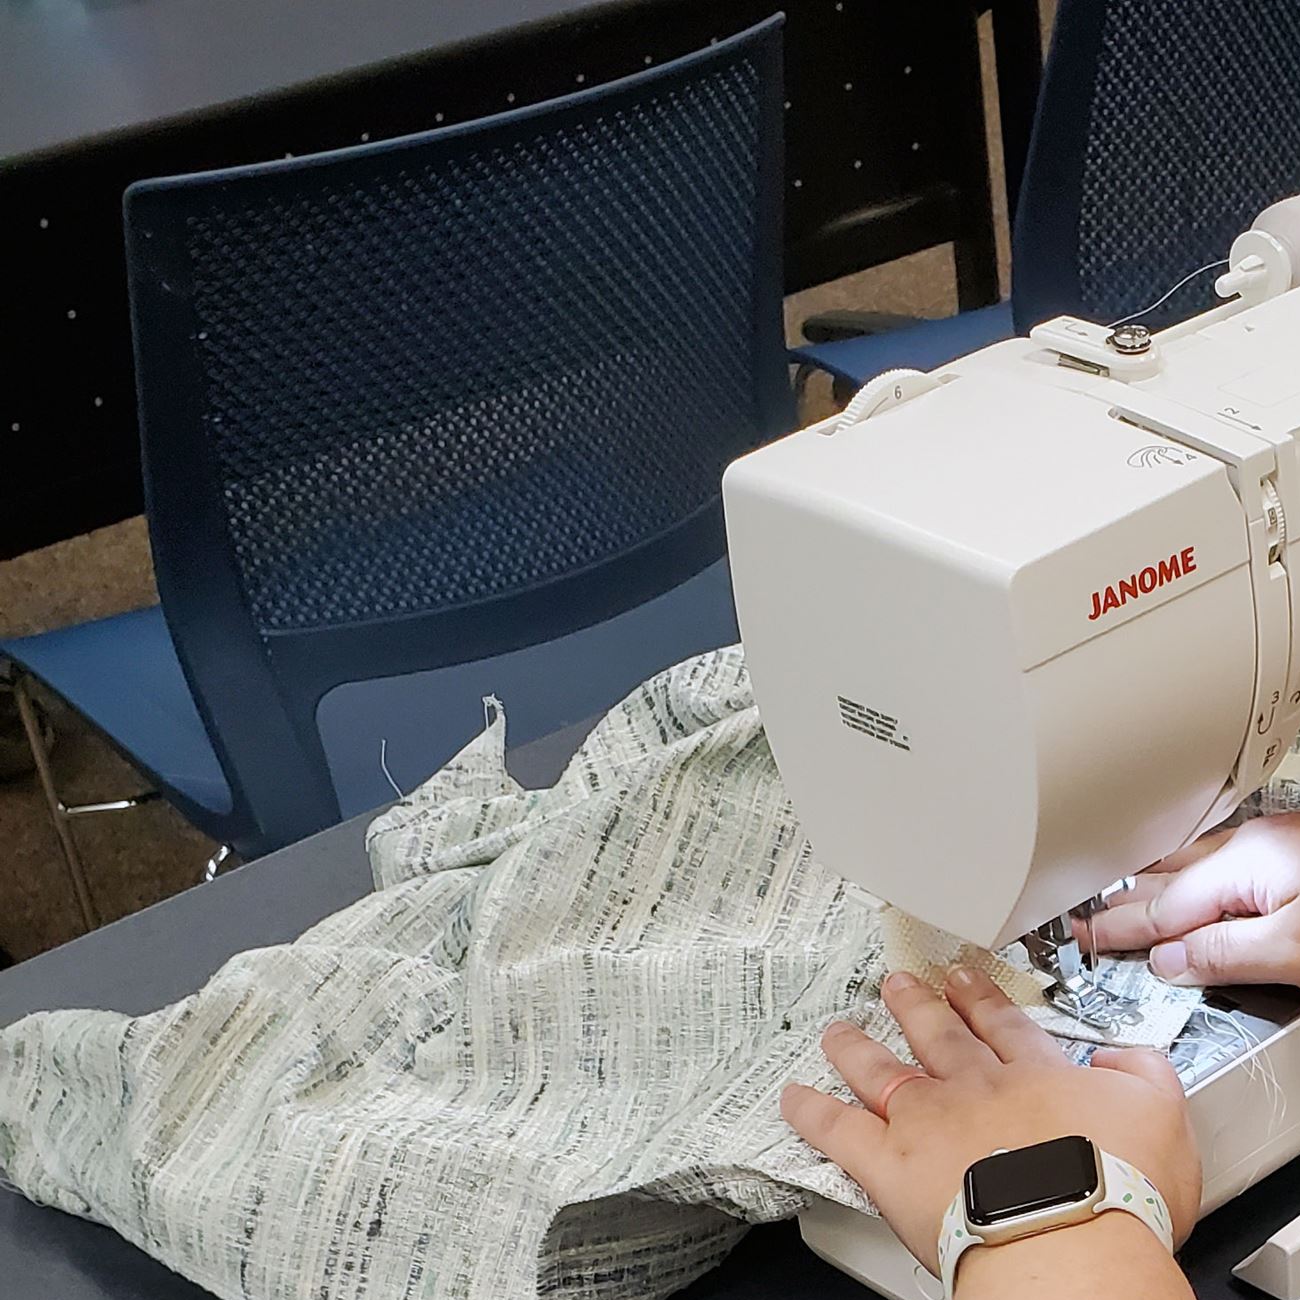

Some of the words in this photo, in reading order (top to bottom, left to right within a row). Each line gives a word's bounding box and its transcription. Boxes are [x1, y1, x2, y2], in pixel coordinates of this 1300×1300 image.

[894, 385, 902, 400] 6
[1088, 546, 1197, 620] JANOME
[1271, 690, 1280, 705] 3
